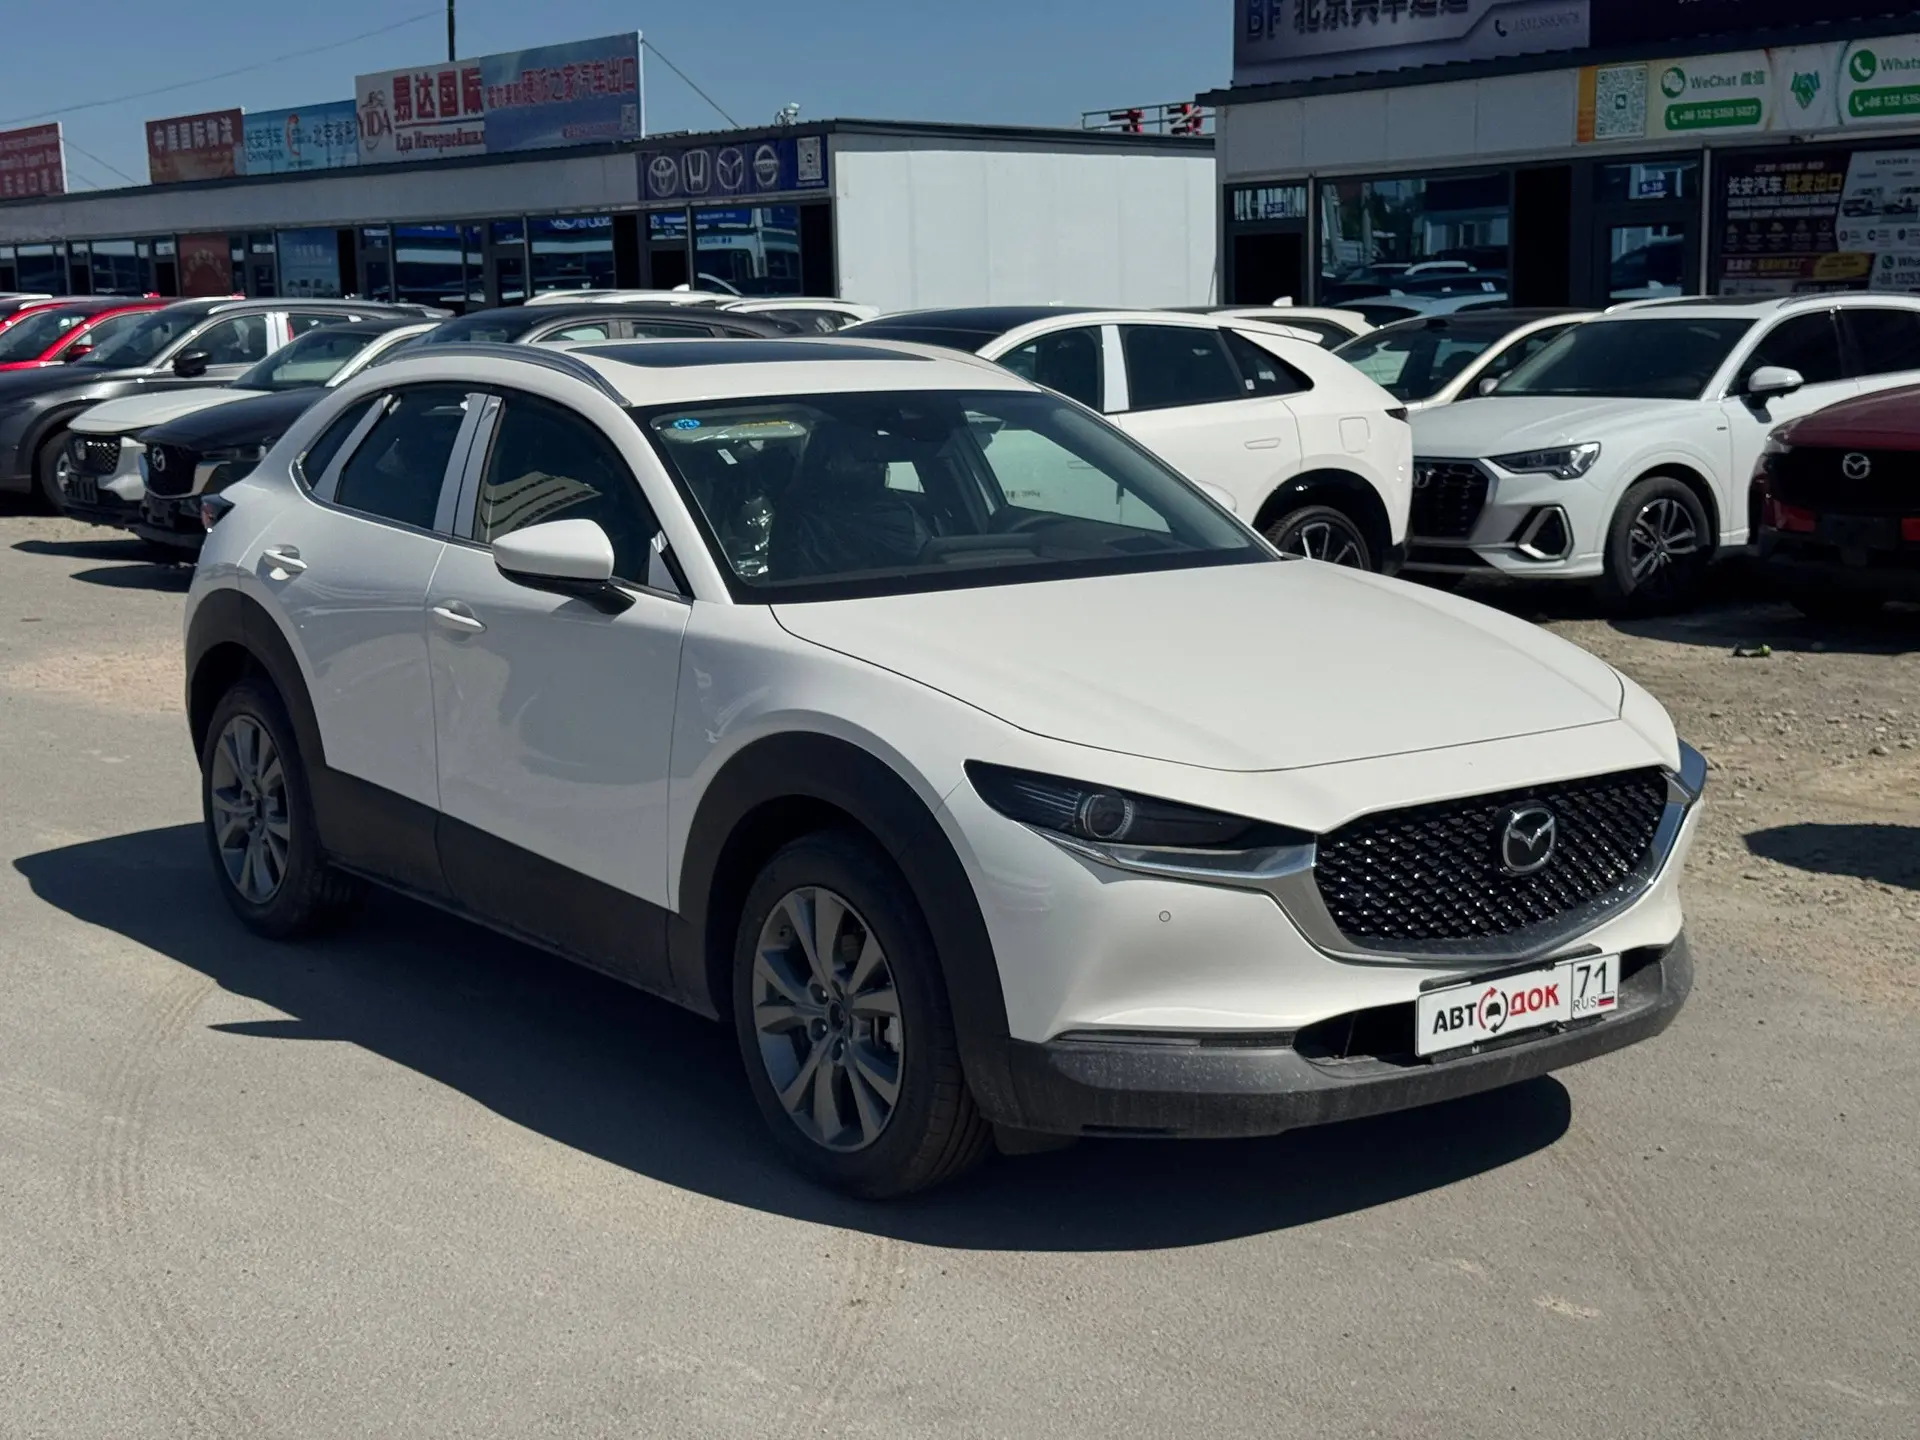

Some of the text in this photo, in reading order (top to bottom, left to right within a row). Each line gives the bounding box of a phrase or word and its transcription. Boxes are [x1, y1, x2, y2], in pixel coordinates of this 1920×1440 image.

[1690, 70, 1765, 89] WeChat 微信
[357, 109, 393, 138] YIDA
[1728, 176, 1782, 195] 长安汽车
[1576, 961, 1608, 998] 71
[1573, 995, 1598, 1013] RUS
